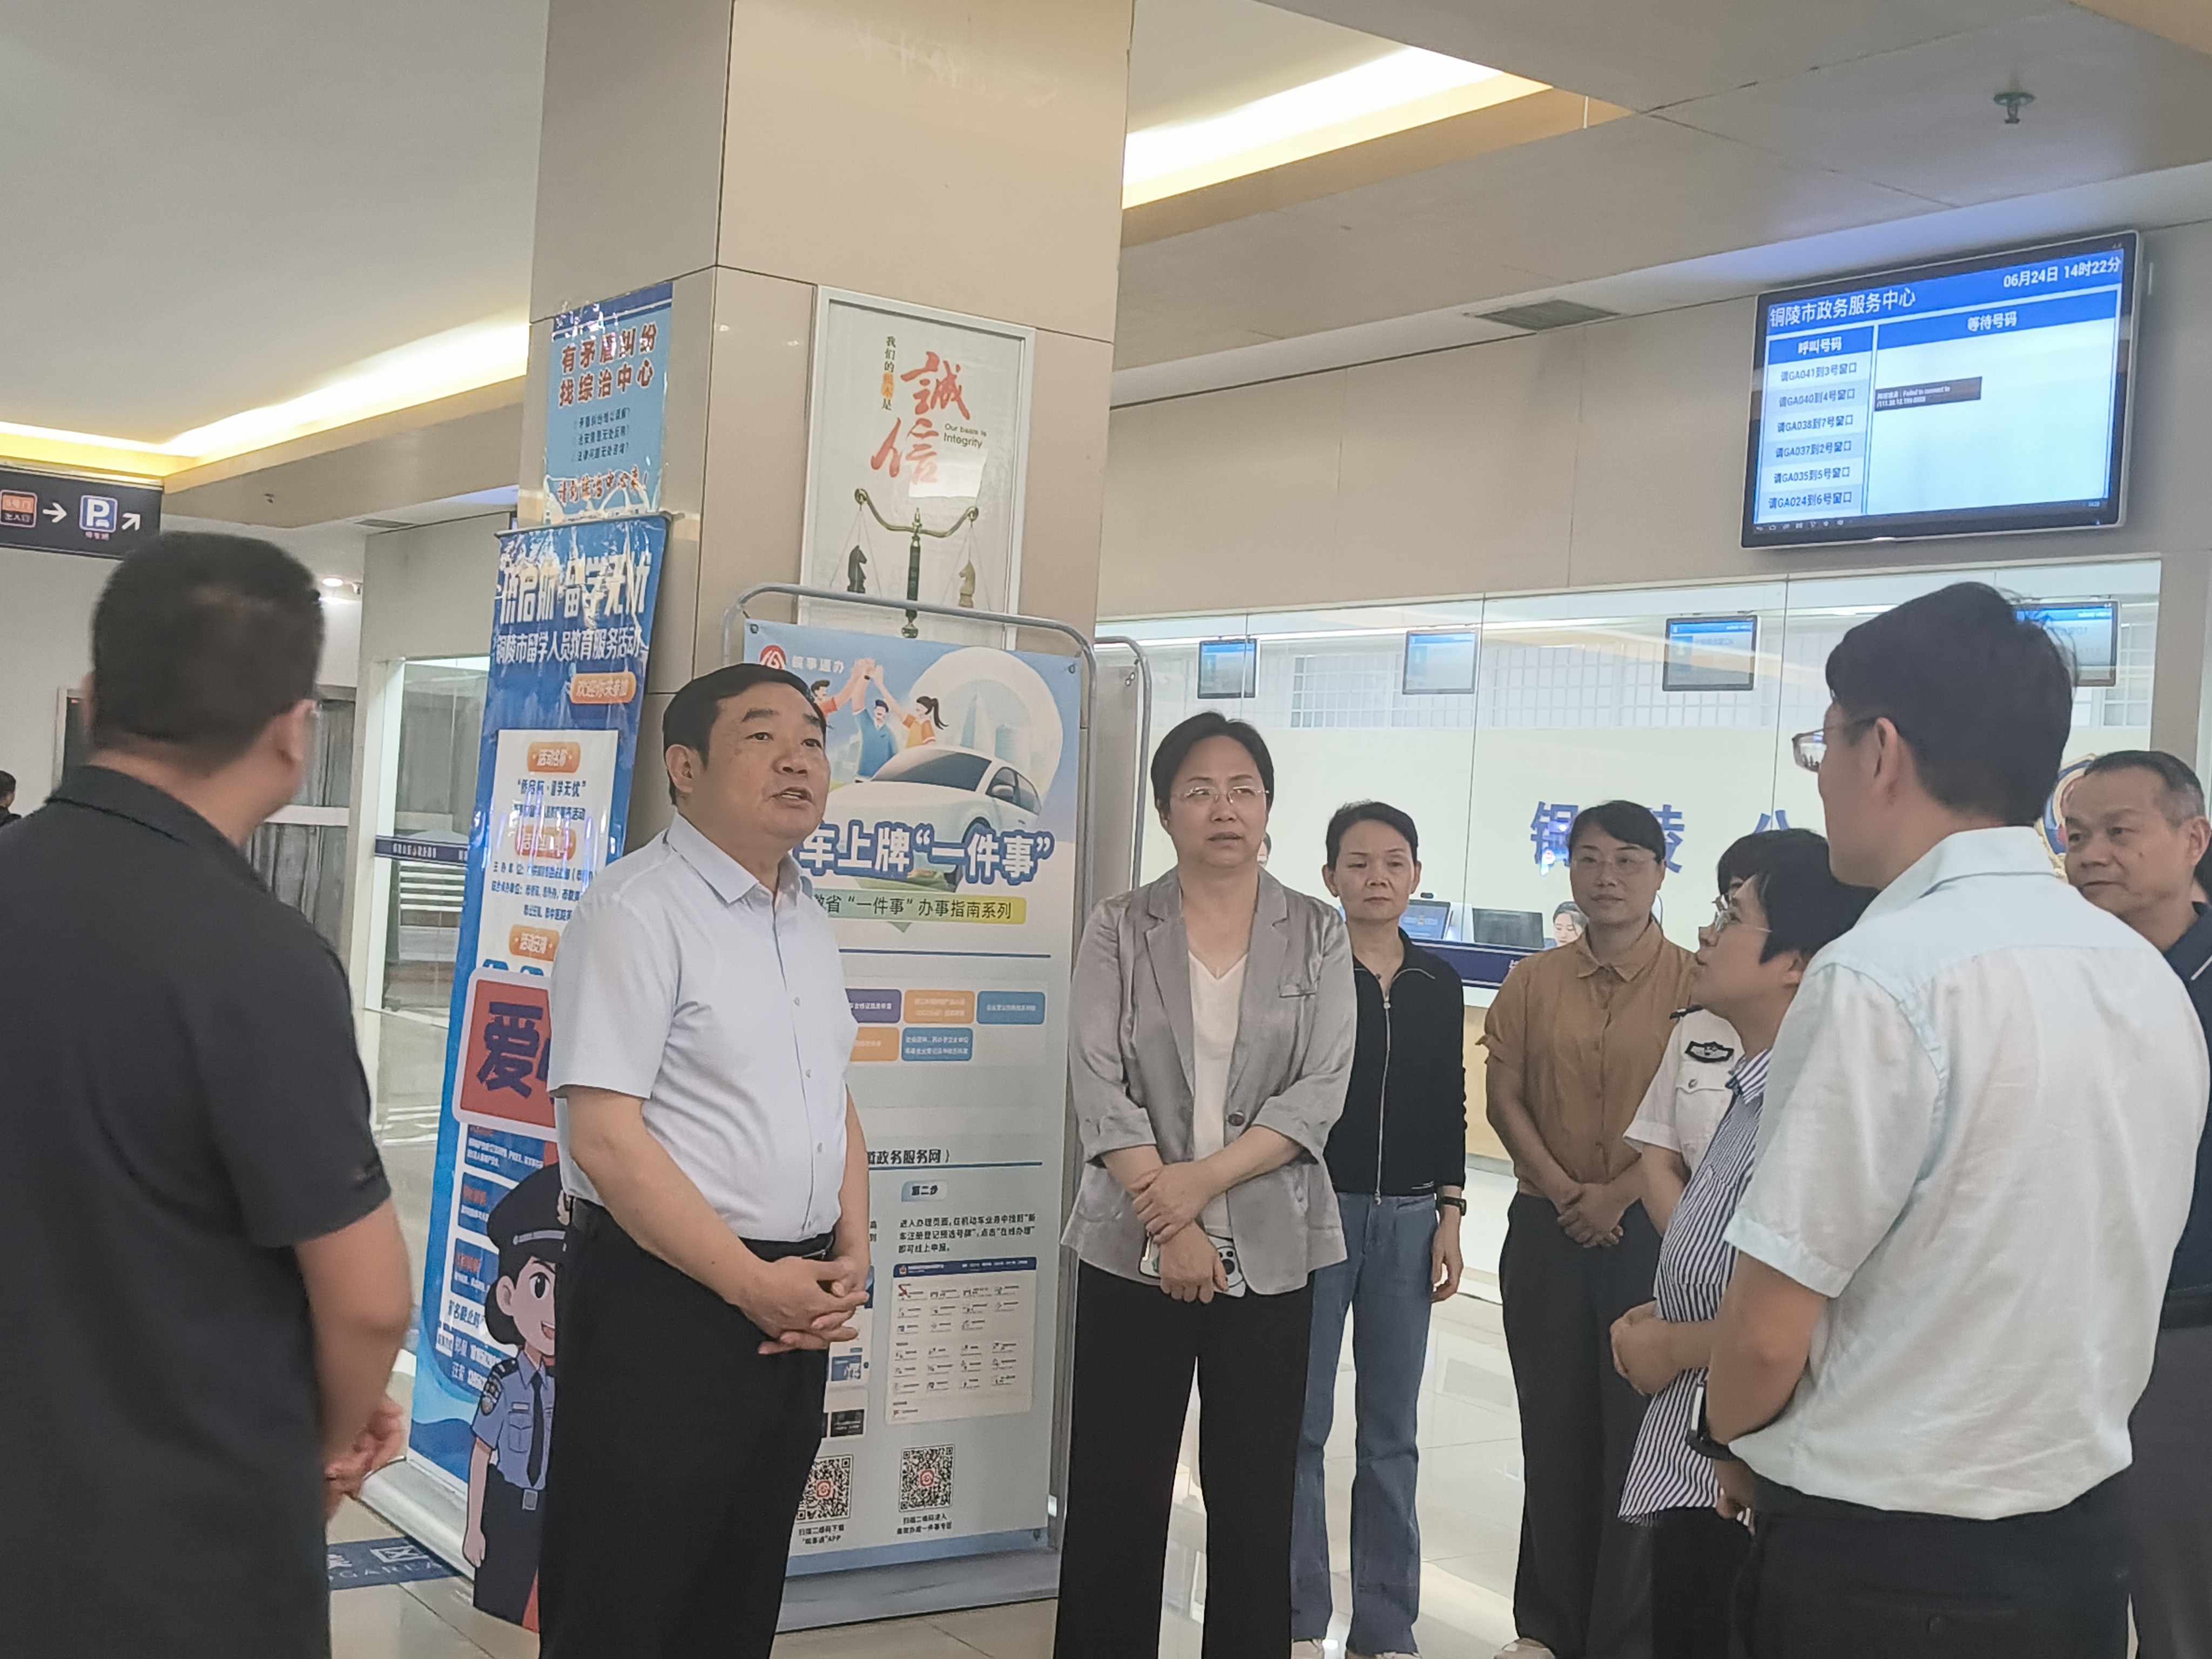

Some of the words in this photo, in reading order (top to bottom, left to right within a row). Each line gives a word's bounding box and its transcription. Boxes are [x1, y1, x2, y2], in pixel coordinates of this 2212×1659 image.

[2003, 264, 2059, 288] 06月24日
[2063, 256, 2122, 280] 14时22分
[1769, 287, 1916, 328] 铜陵市政务服务中心
[1967, 311, 2018, 333] 等待号码
[561, 321, 658, 374] 有矛盾纠纷
[1797, 336, 1843, 355] 呼叫号码
[558, 359, 654, 408] 找综治中心
[945, 423, 958, 431] Our
[943, 432, 983, 449] Integrity
[1768, 491, 1852, 510] 请GA024到6号窗口
[911, 1184, 939, 1196] 第二步
